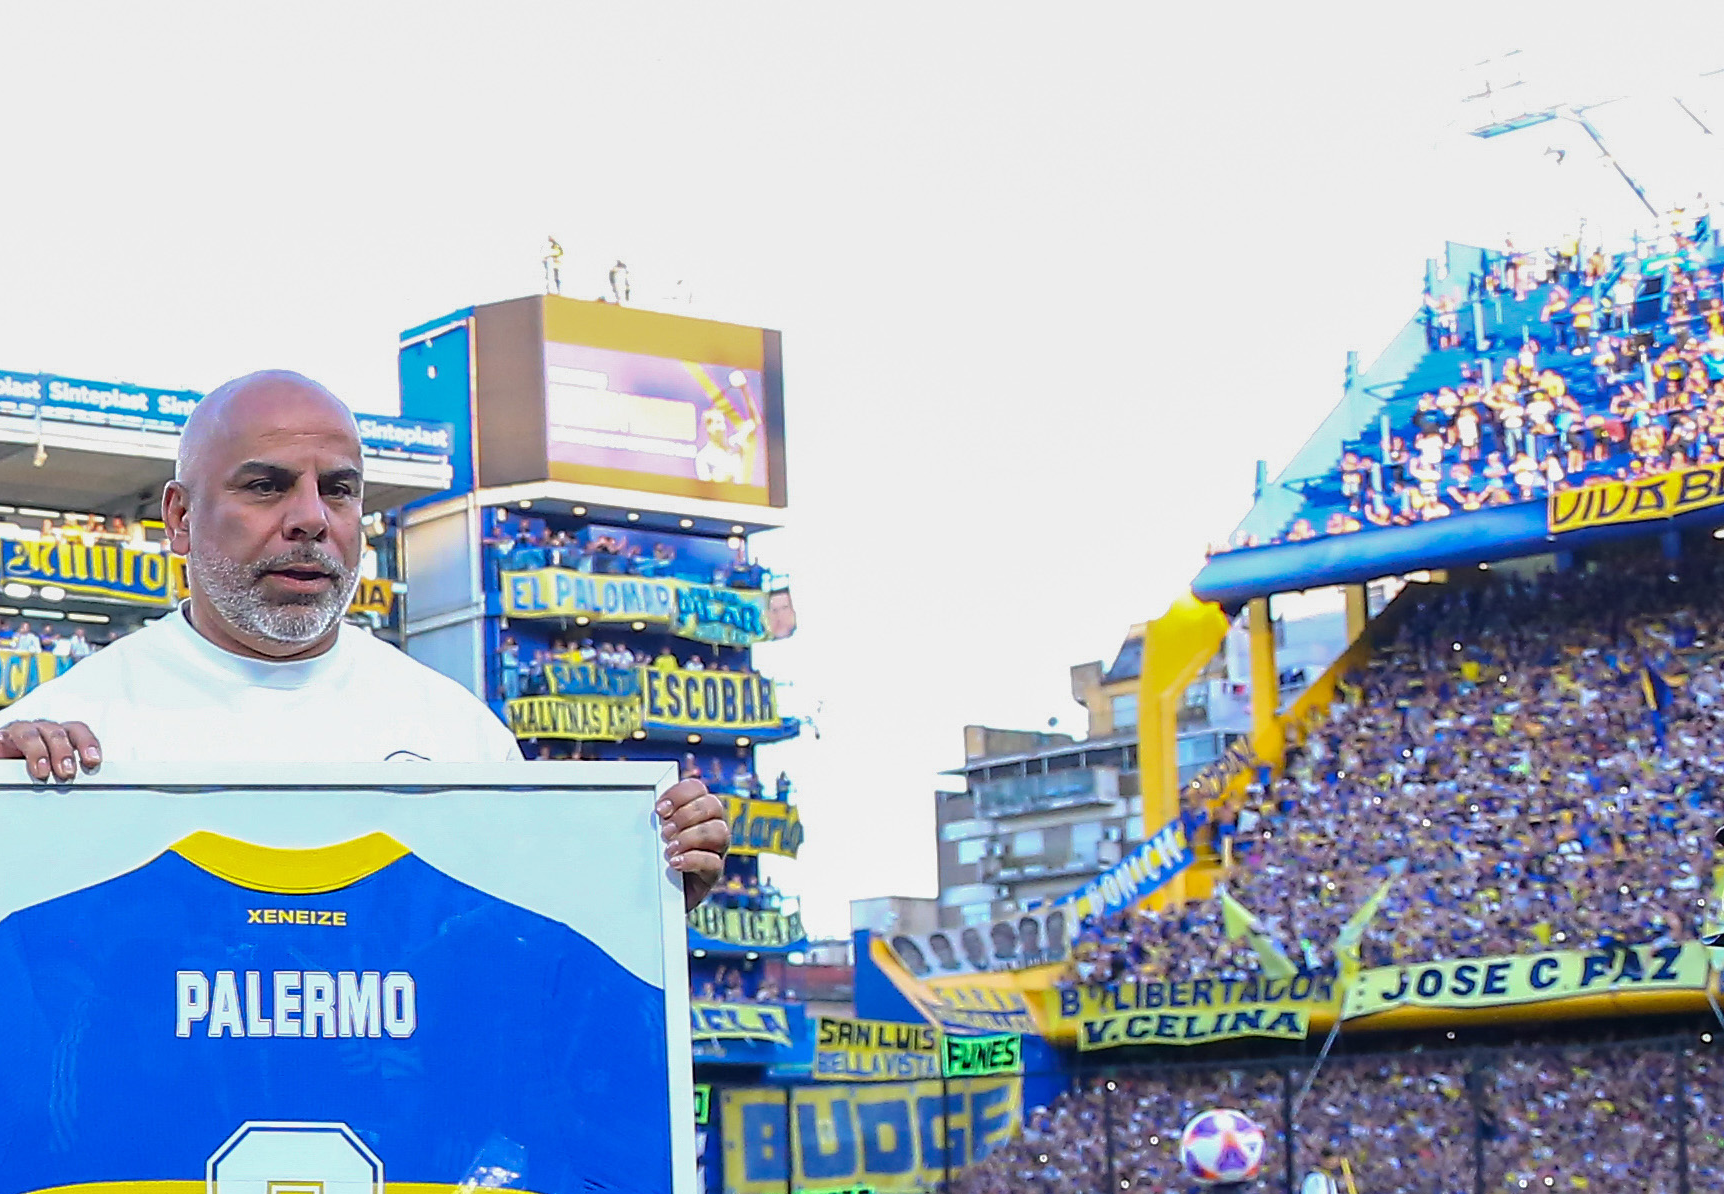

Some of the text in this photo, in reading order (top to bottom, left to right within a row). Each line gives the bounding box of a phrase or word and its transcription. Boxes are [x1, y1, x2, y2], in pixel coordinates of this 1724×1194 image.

[49, 381, 149, 412] Sinteplast
[511, 576, 548, 610] EL
[646, 669, 773, 724] ESCOBAR
[247, 909, 347, 926] XENEIZE
[1381, 962, 1512, 1001] JOSE
[176, 971, 416, 1038] PALERMO
[819, 1018, 936, 1050] SAN LUIS
[947, 1038, 1018, 1071] FUNES
[742, 1084, 1011, 1183] BUDGE
